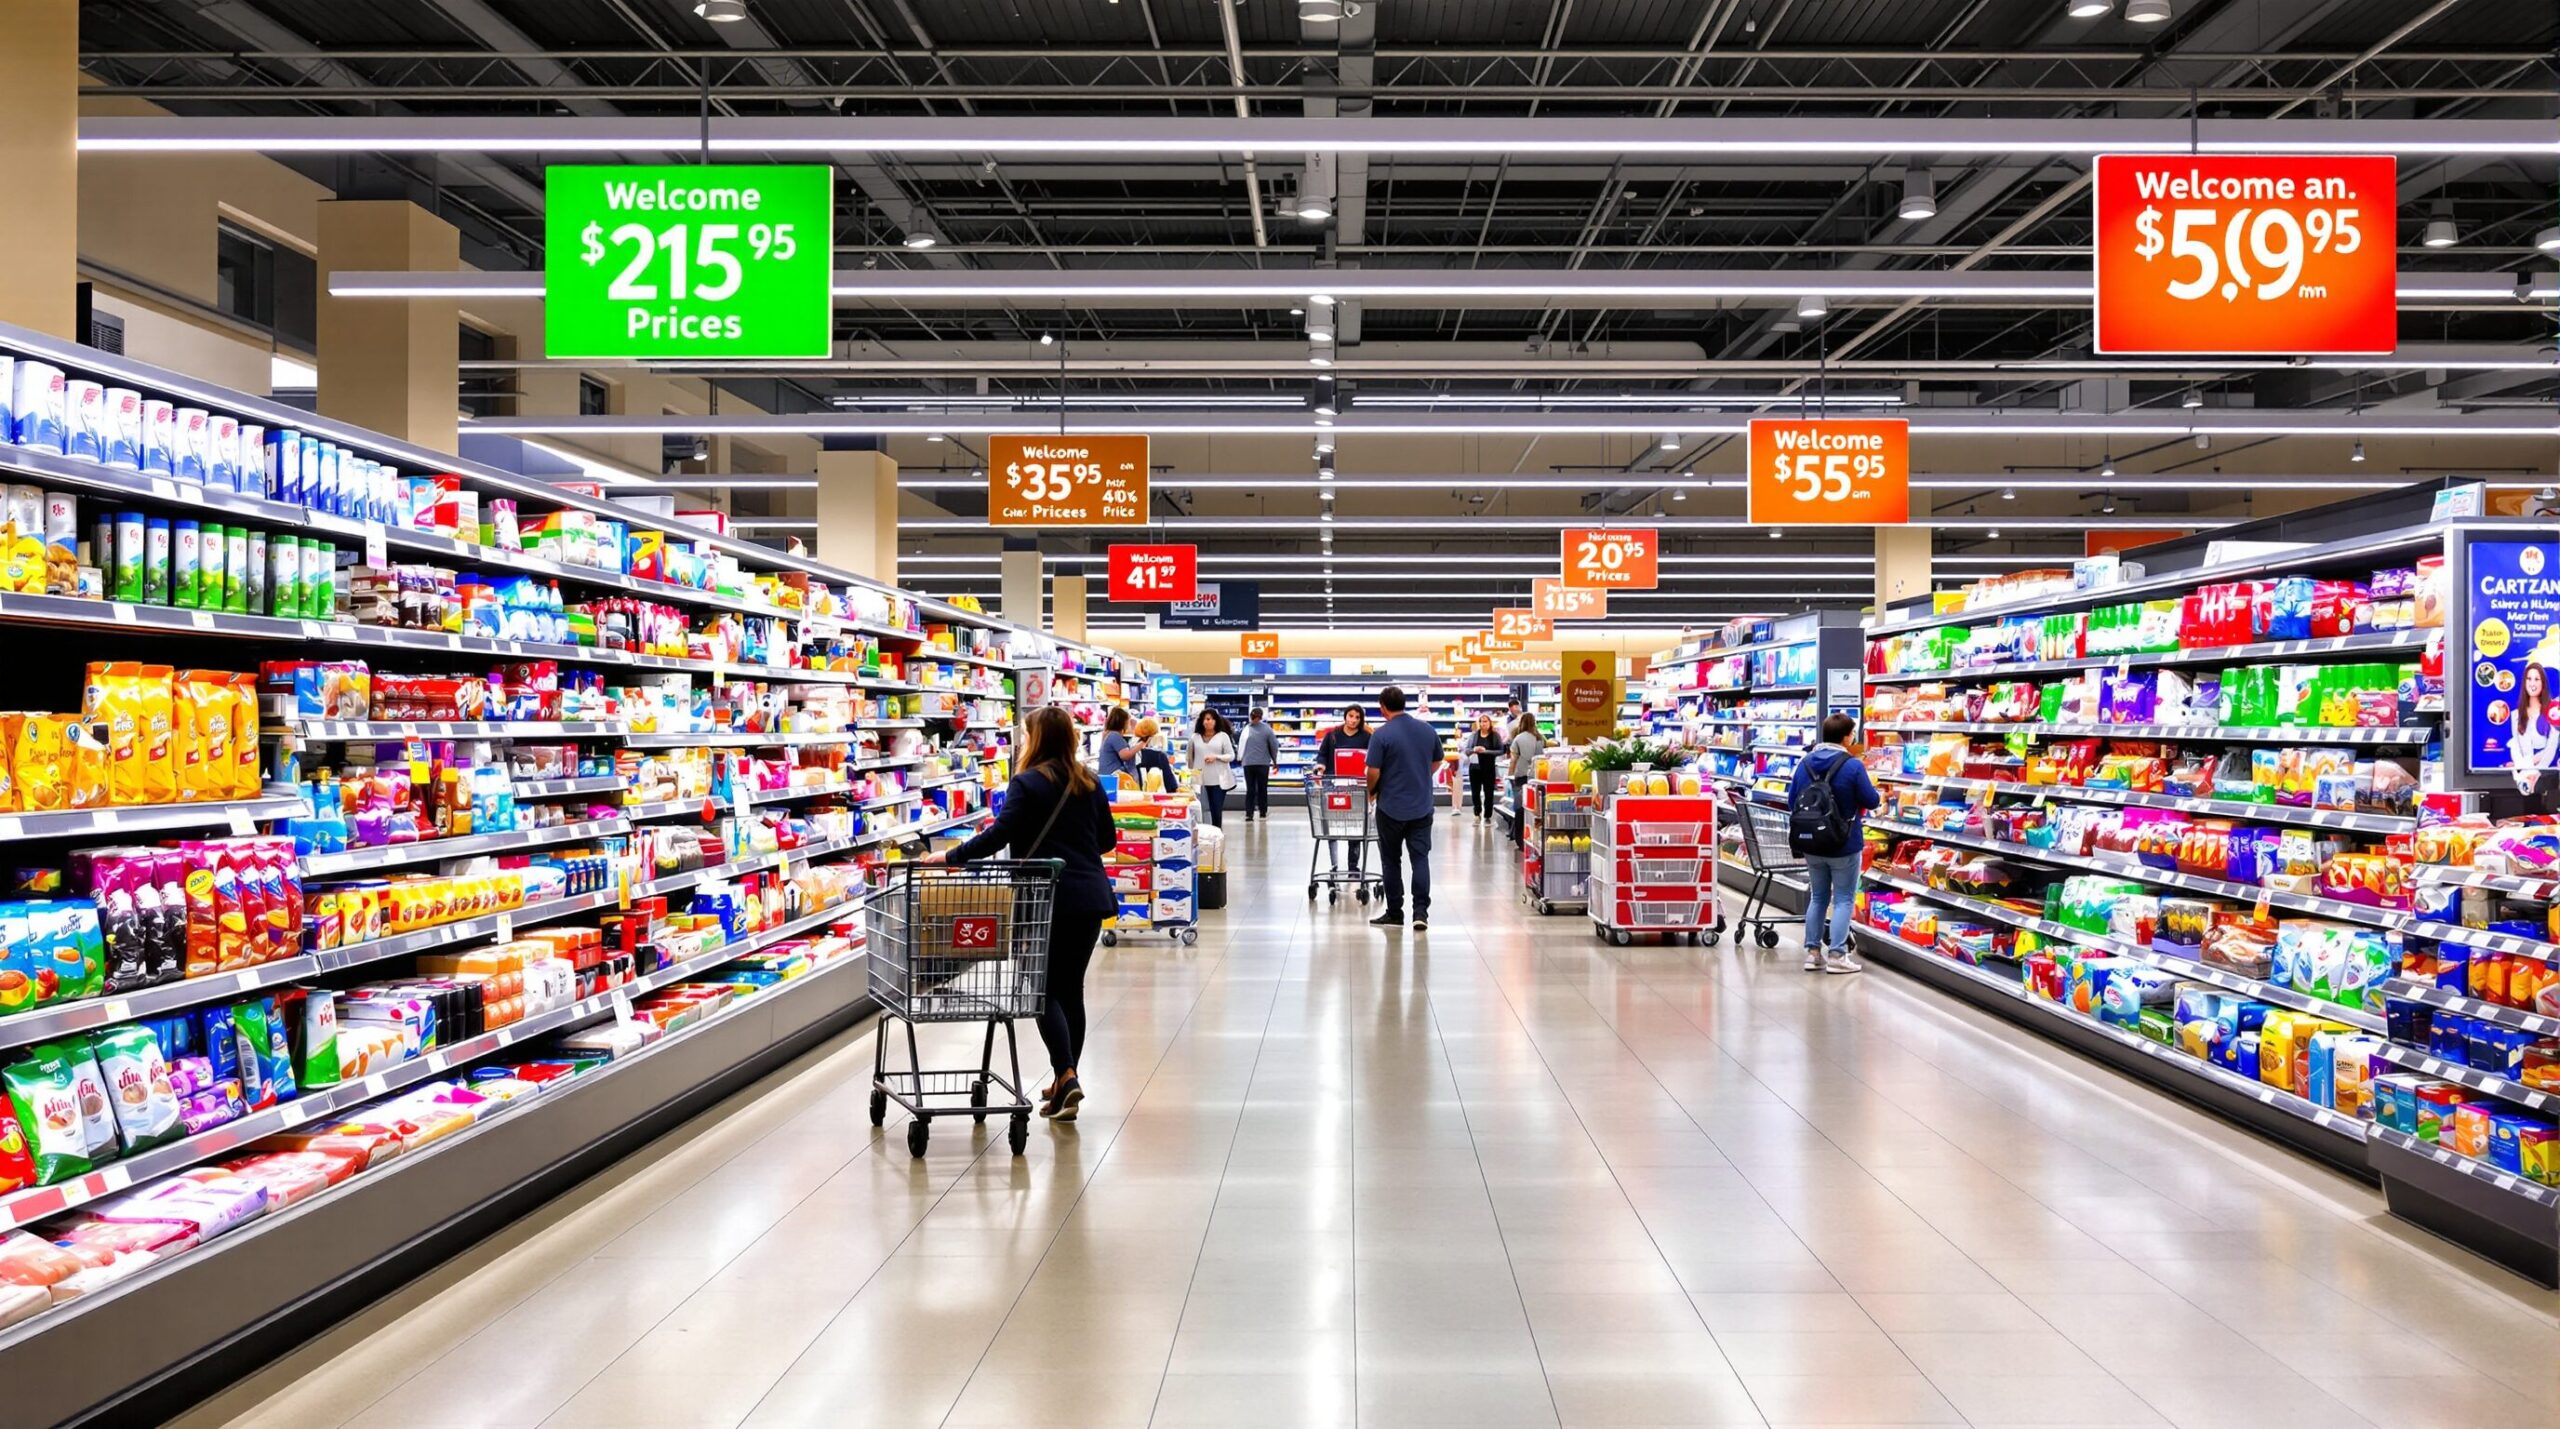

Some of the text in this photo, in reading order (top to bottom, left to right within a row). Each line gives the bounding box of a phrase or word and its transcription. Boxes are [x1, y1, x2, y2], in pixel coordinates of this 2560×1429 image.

[604, 180, 761, 210] Welcome
[2135, 169, 2357, 199] Welcome an.
[627, 306, 743, 339] Prices
[1022, 445, 1089, 459] Welcome
[1773, 429, 1883, 450] Welcome
